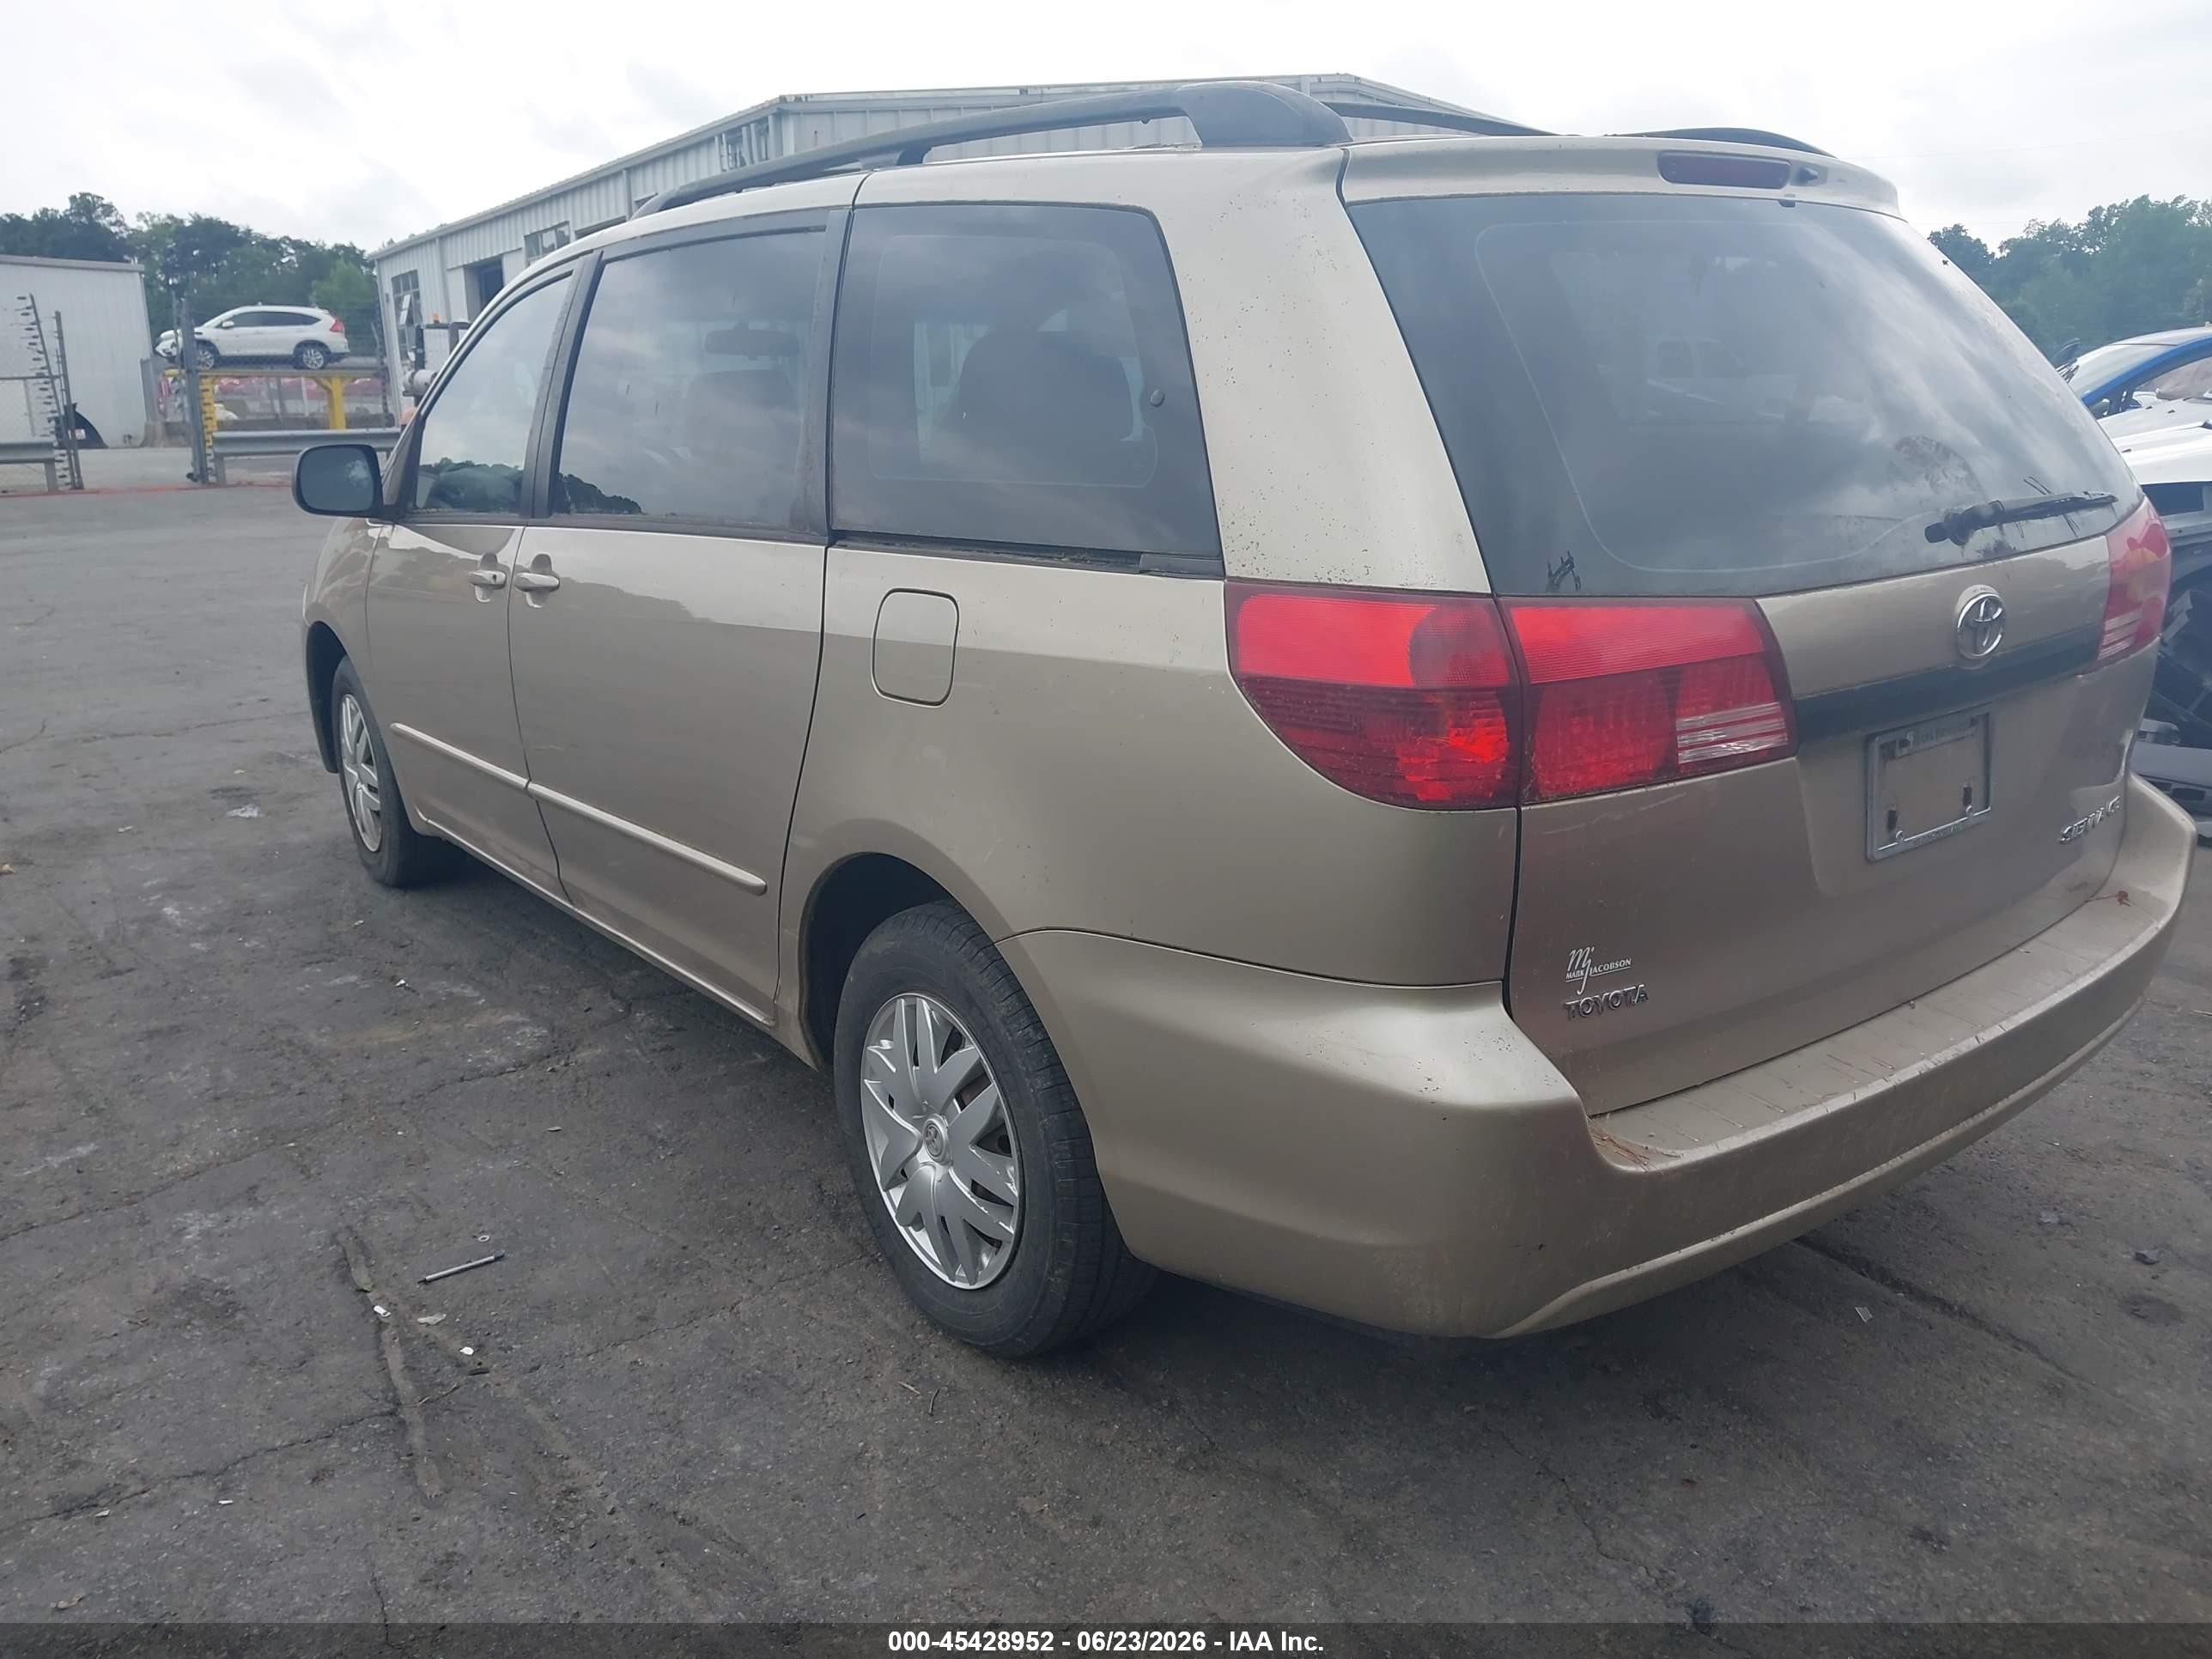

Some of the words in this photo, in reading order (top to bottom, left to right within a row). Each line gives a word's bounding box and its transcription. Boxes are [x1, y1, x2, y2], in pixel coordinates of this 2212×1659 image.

[1565, 969, 1585, 980] MARK
[1589, 958, 1632, 976] JACOBSON
[1563, 984, 1648, 1020] TOYOTA
